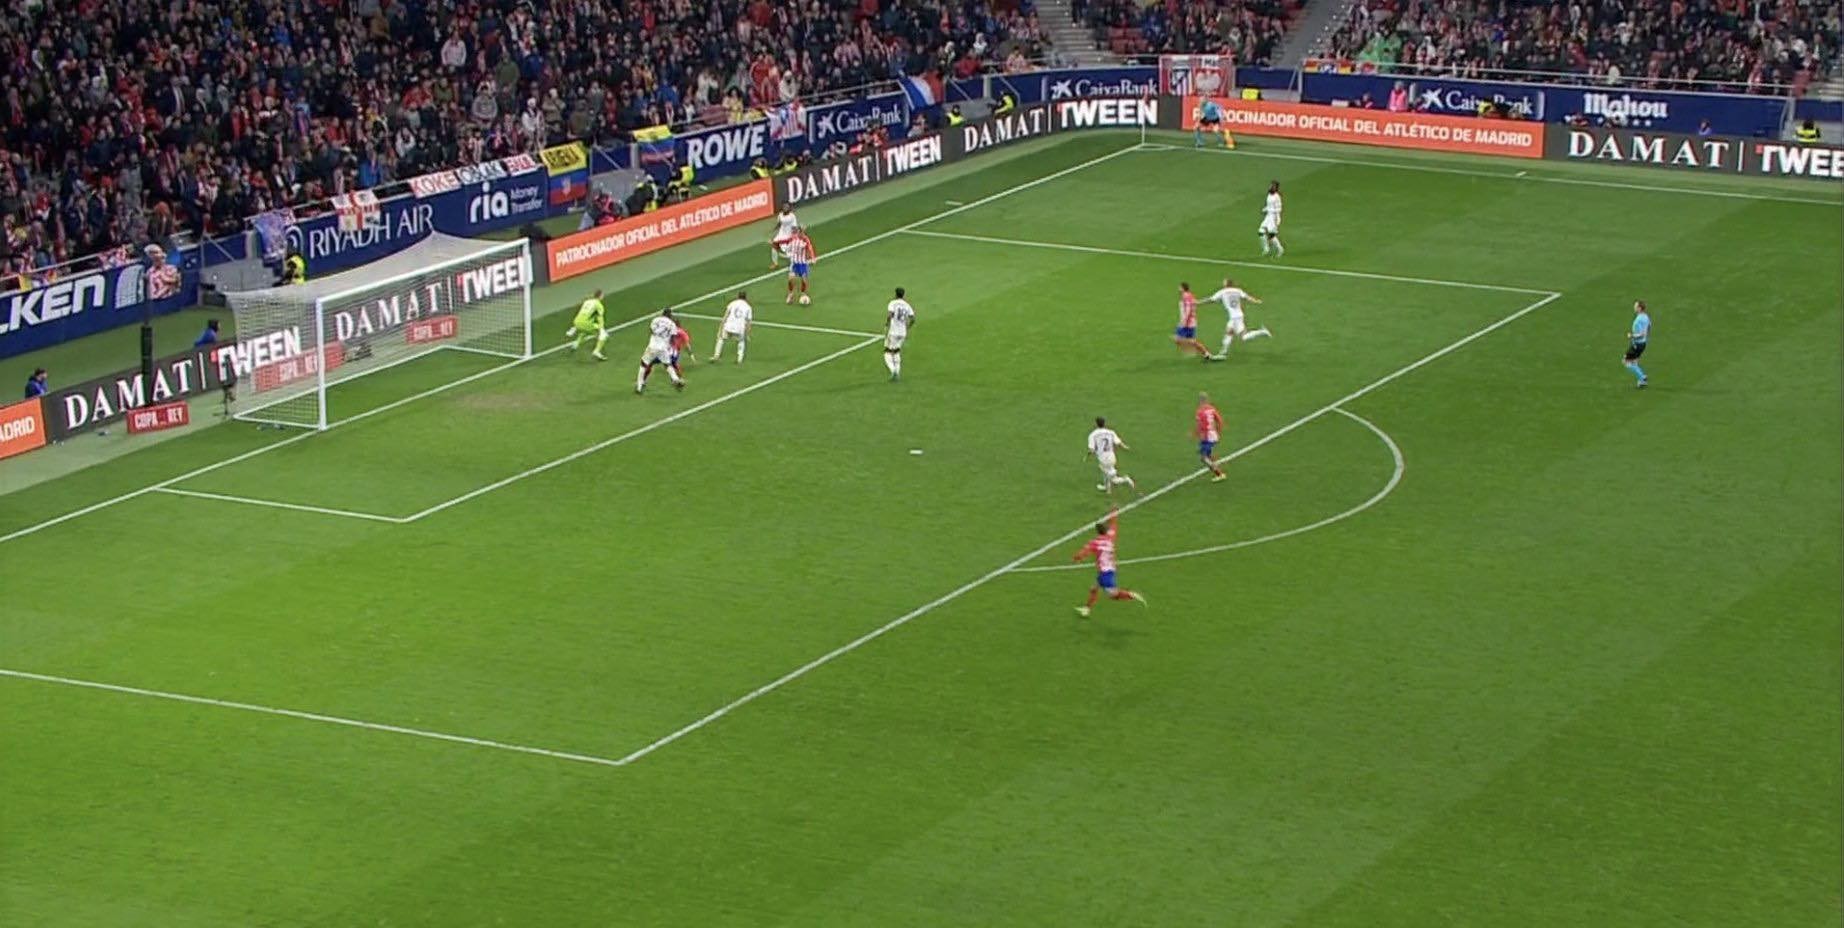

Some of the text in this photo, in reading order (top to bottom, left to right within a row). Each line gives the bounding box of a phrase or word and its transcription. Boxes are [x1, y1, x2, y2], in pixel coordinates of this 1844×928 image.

[1076, 78, 1158, 97] CaixaBank
[1584, 92, 1668, 118] Mahou
[964, 99, 1158, 151] DAMAT TWEEN
[1299, 117, 1351, 133] OFICIAL
[1353, 119, 1379, 136] DEL
[1385, 121, 1450, 140] ATLÉTICO
[1453, 127, 1473, 142] DE
[1475, 129, 1532, 147] MADRID
[686, 126, 764, 168] ROWE
[1568, 131, 1729, 168] DAMAT
[788, 135, 942, 203] DAMAT TWEEN
[470, 181, 509, 223] ria
[309, 203, 435, 259] RIYADH AIR
[556, 234, 626, 267] PATROCINADOR
[626, 223, 660, 244] OFICIAL
[661, 217, 680, 235] DEL
[722, 203, 734, 218] DE
[735, 191, 768, 212] MADRID
[336, 282, 442, 341] DAMAT
[65, 326, 301, 430] DAMAT TWEEN
[134, 409, 158, 429] COPA
[168, 406, 184, 423] REY
